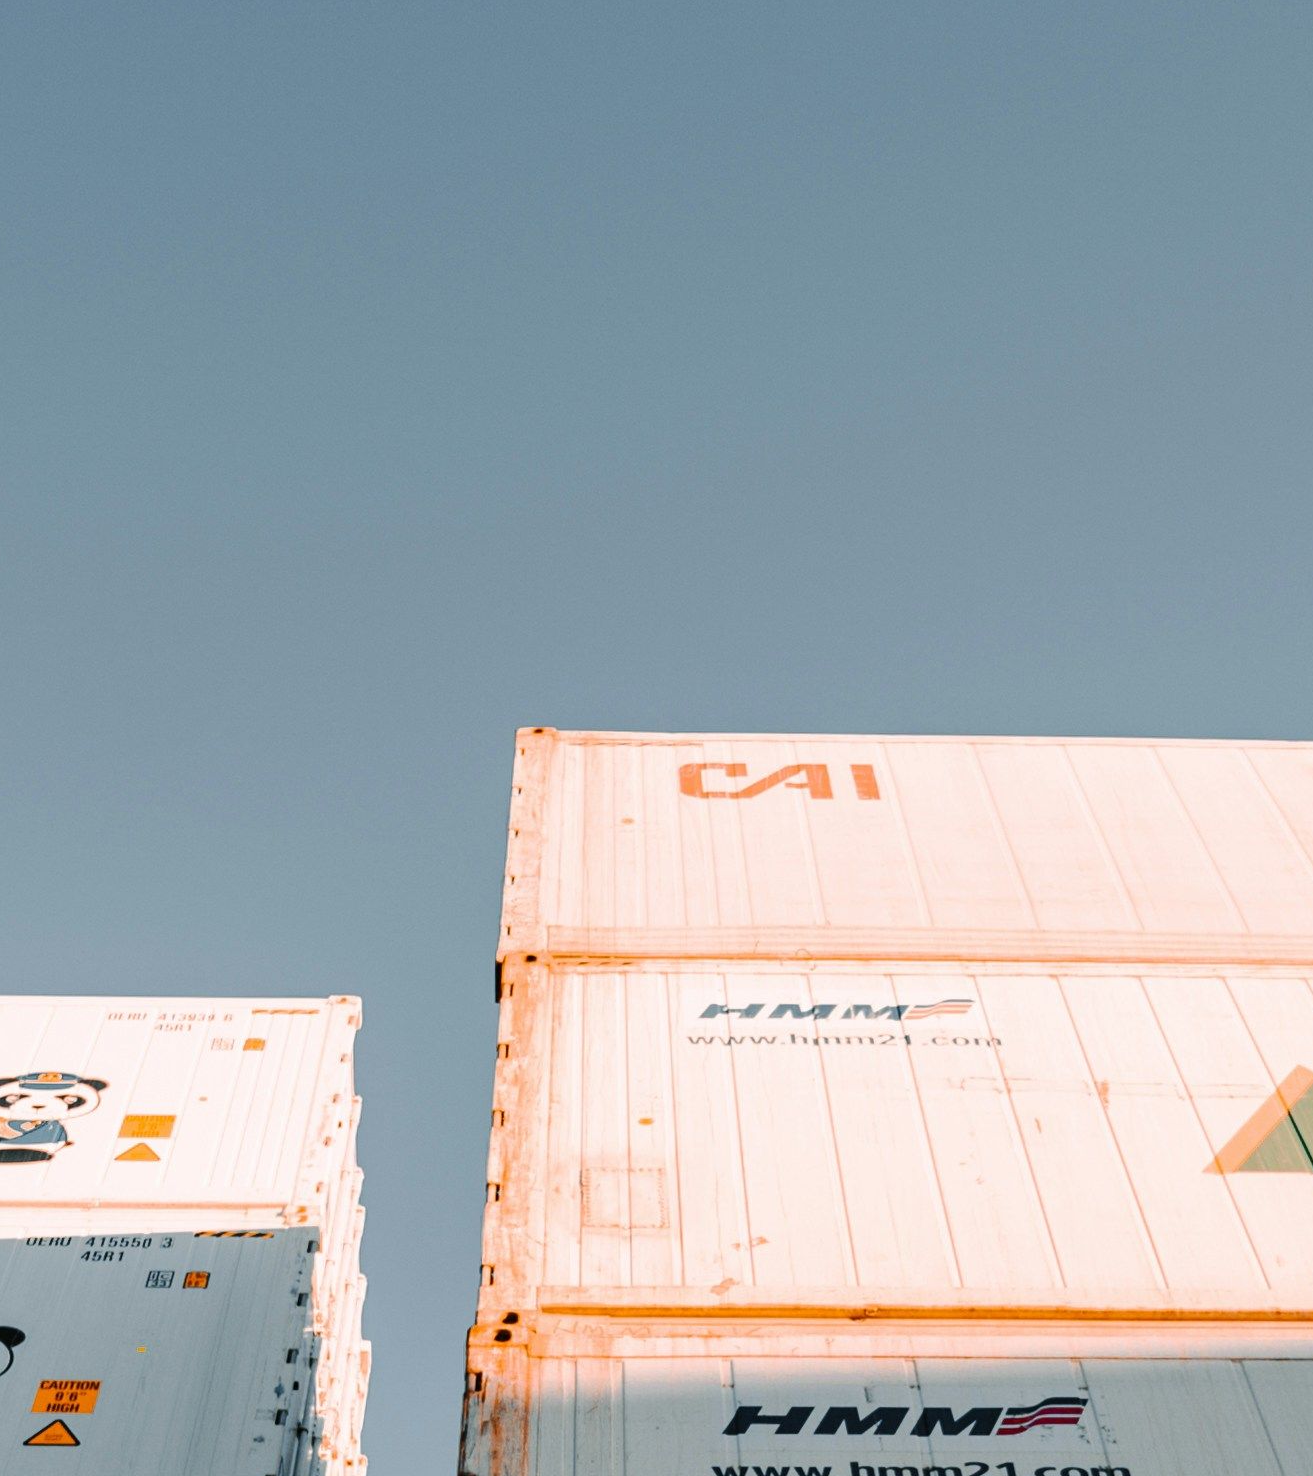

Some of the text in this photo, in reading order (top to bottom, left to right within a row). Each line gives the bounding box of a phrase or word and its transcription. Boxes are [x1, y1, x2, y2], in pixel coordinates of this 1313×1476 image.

[679, 763, 881, 800] CAI
[698, 1003, 910, 1021] HMM
[687, 1033, 1003, 1048] www.hmm21.com
[85, 1237, 153, 1248] 415550
[159, 1237, 173, 1248] 3
[80, 1250, 125, 1262] 45R1
[40, 1381, 100, 1390] CAUTION
[46, 1404, 80, 1413] HIGH
[722, 1406, 1005, 1437] HMM
